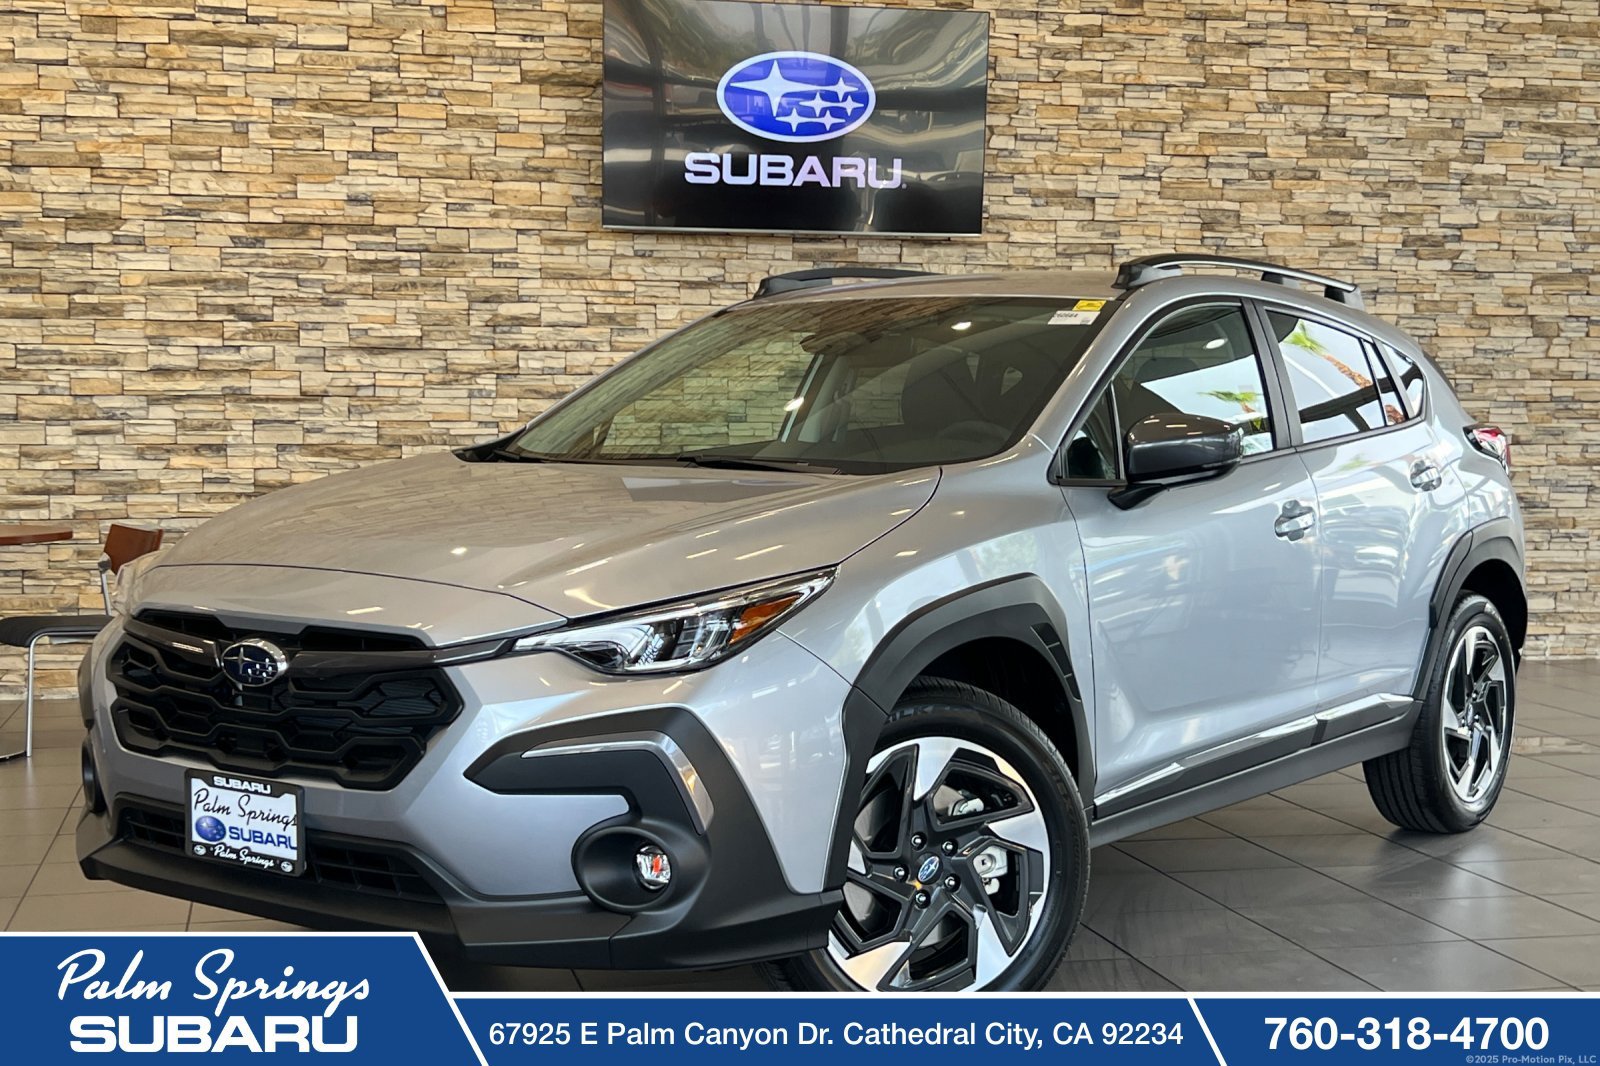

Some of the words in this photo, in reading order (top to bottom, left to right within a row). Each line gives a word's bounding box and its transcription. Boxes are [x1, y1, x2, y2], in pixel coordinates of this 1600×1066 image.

[684, 152, 904, 190] SUBARU
[213, 776, 271, 794] SUBARU
[194, 788, 231, 815] Palm
[238, 794, 297, 832] Springs
[213, 844, 237, 860] Palm
[239, 849, 274, 868] Springs
